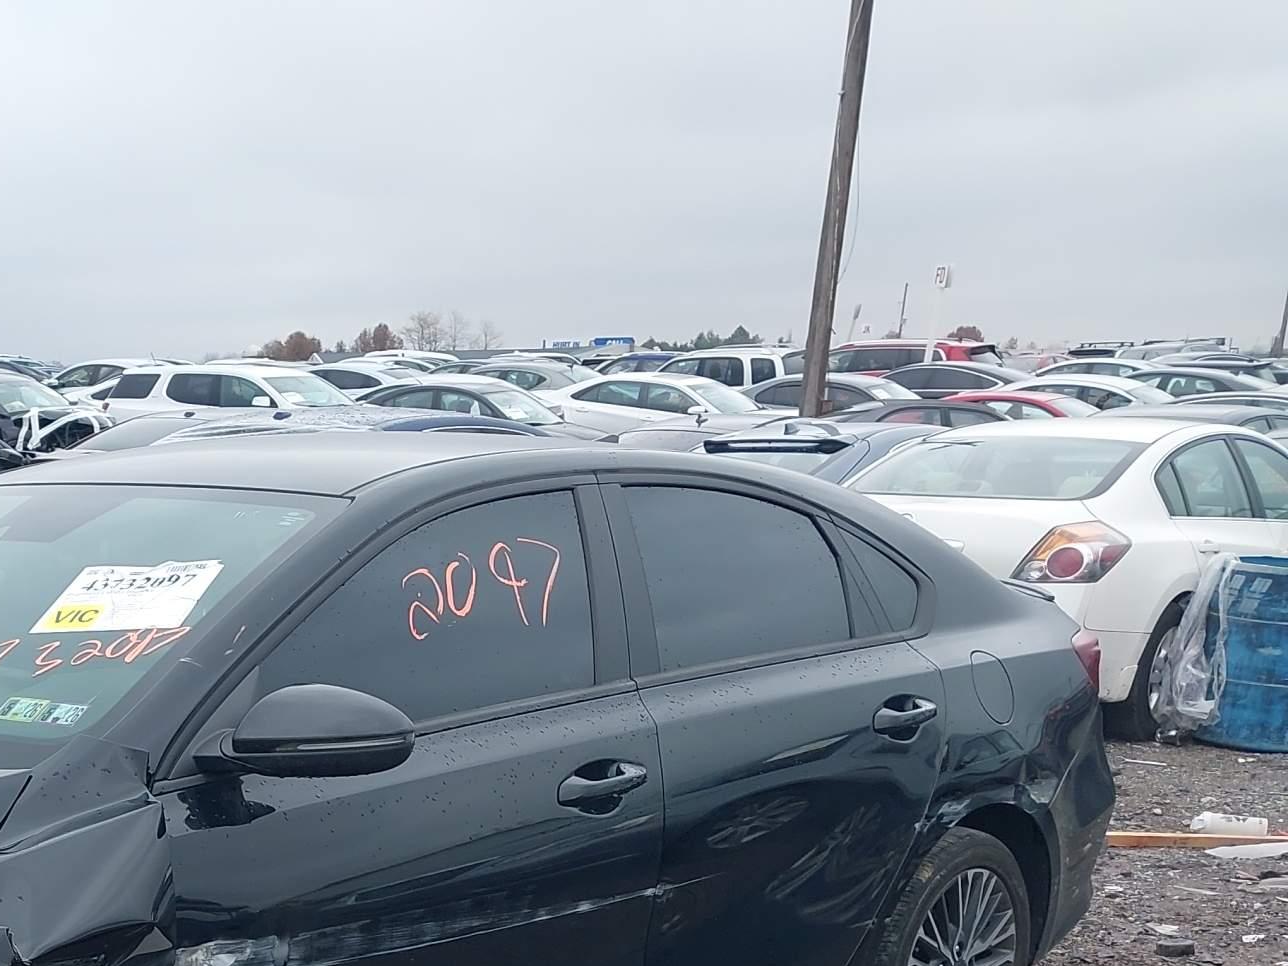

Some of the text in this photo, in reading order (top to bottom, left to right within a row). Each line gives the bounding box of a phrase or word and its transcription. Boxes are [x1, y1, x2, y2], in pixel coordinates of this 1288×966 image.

[81, 573, 197, 591] 43732097
[401, 537, 560, 640] 2097
[54, 609, 99, 624] VIC
